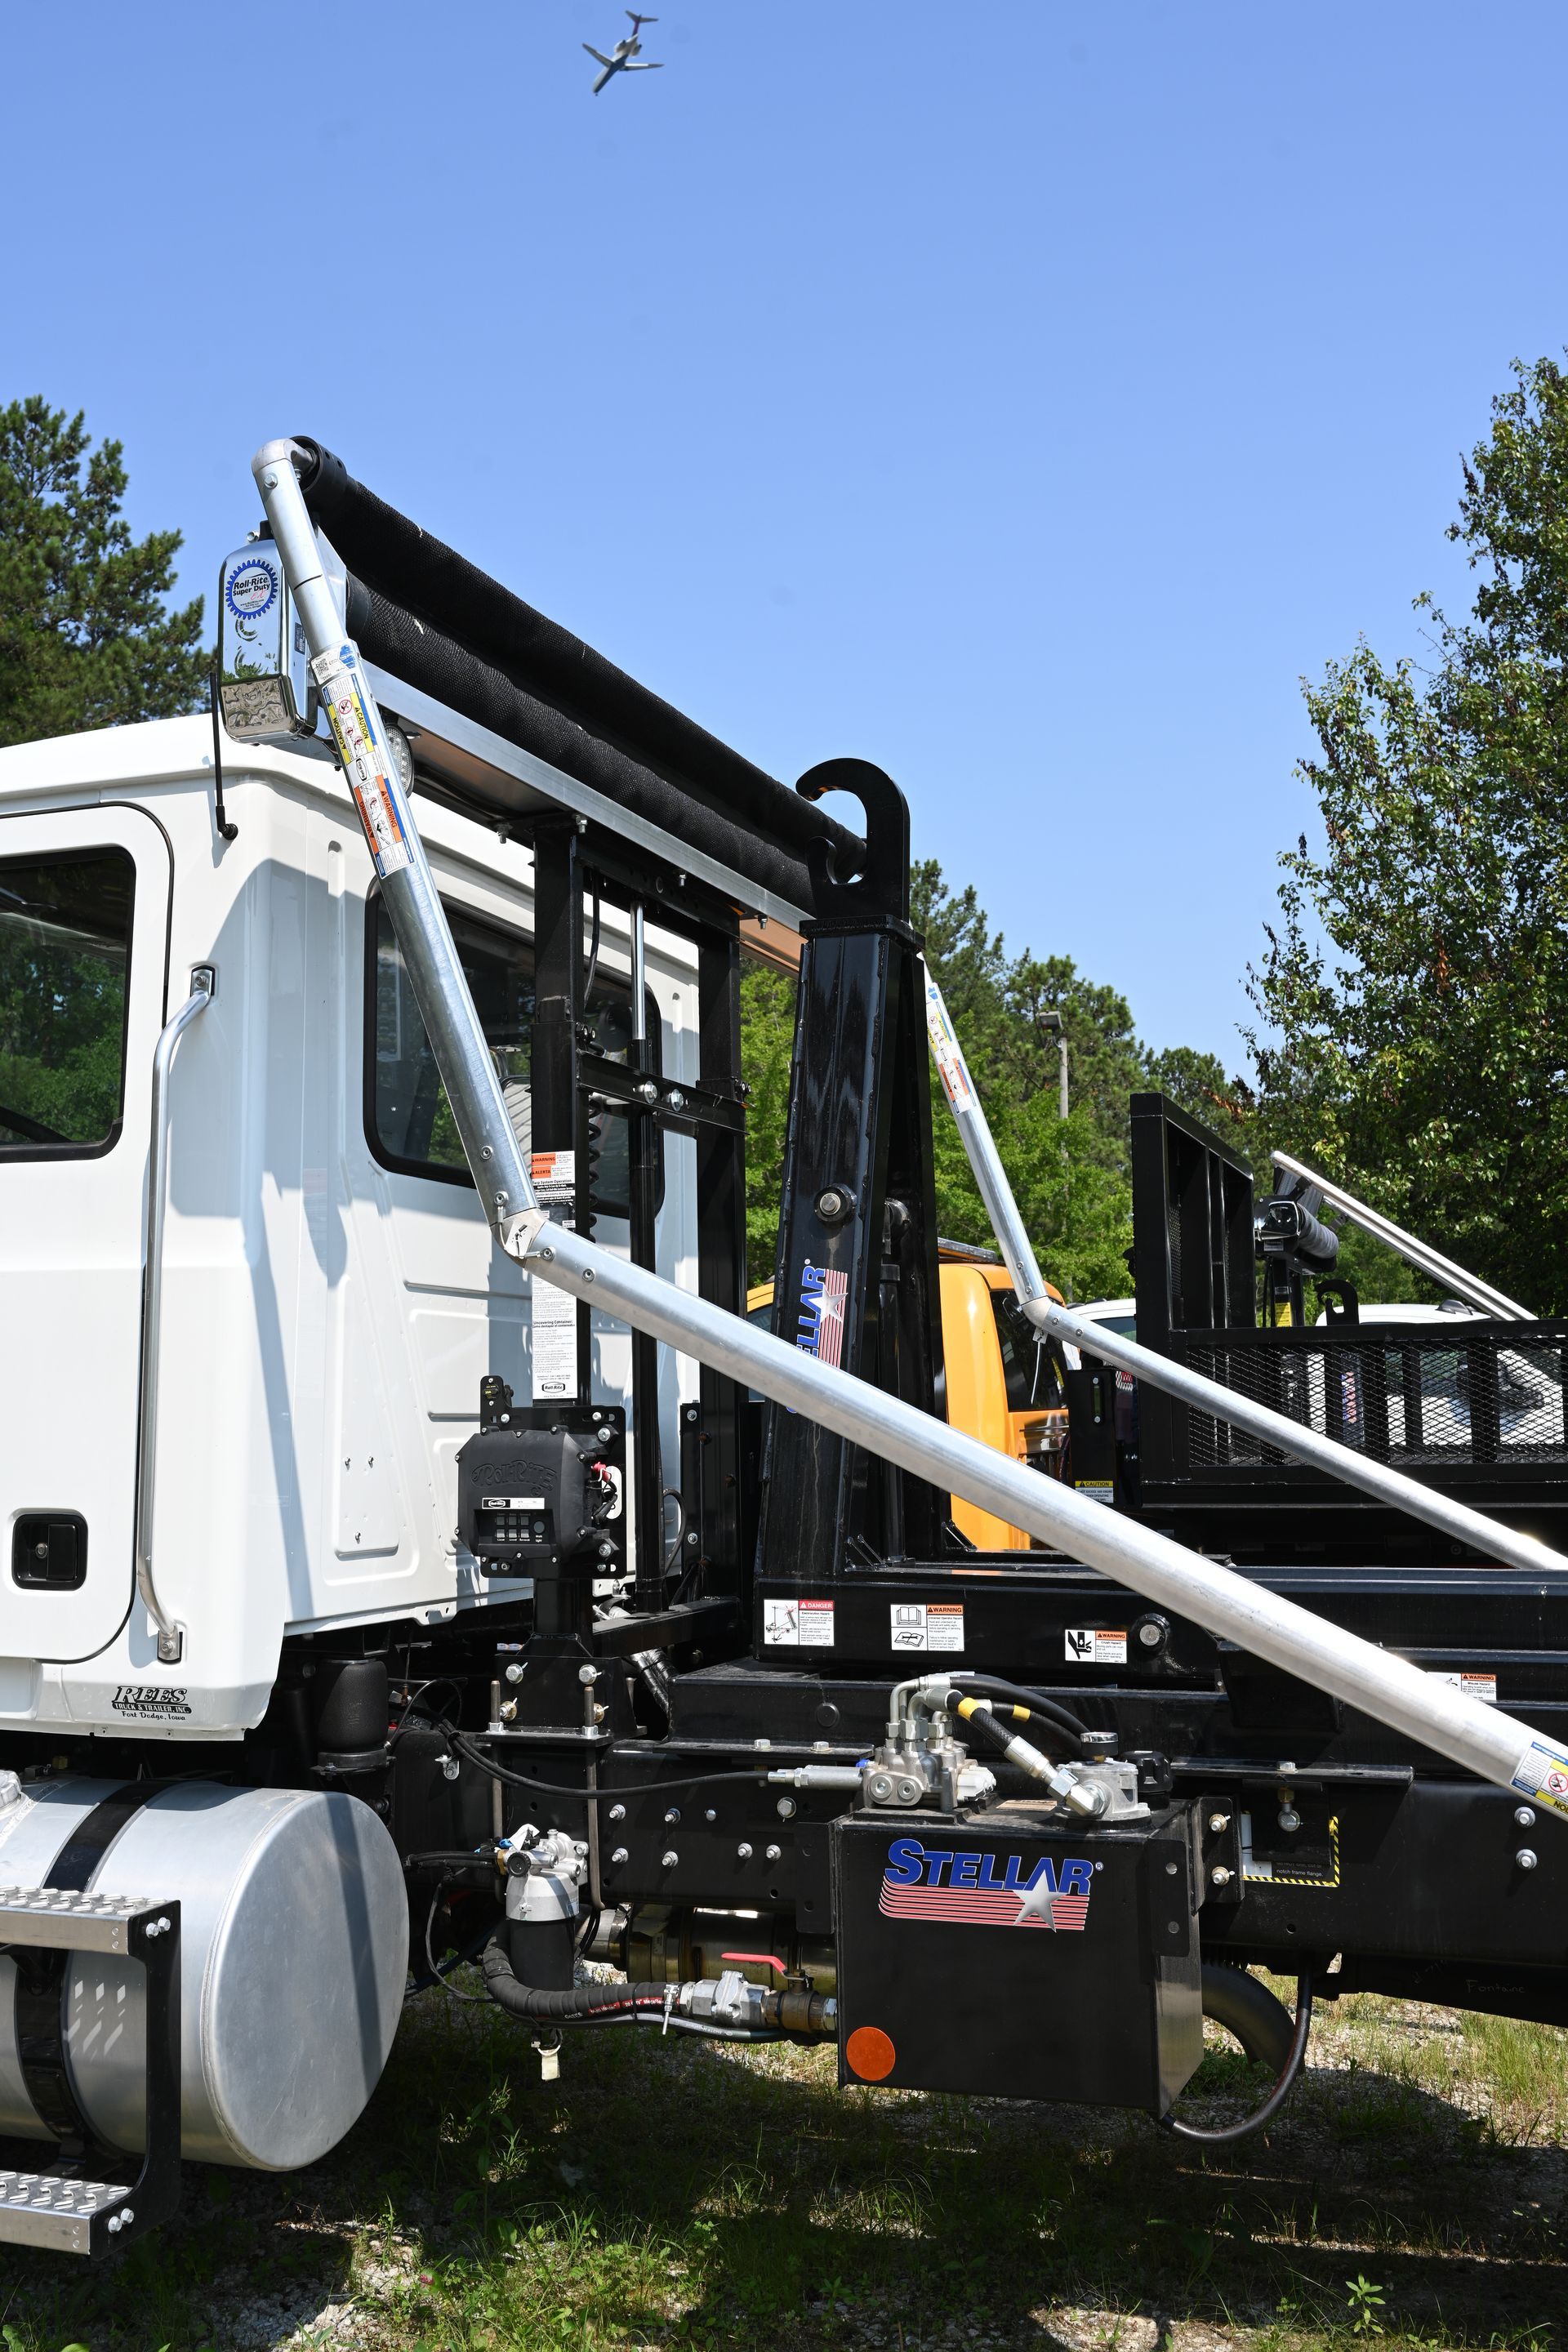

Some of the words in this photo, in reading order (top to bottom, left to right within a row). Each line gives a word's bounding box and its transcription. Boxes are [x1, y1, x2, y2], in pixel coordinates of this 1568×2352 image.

[233, 587, 252, 596] Super
[254, 583, 270, 591] Duty
[332, 717, 345, 744] CAUTION
[356, 712, 369, 739] CAUTION
[359, 801, 373, 833] WARNING
[383, 796, 398, 828] WARNING
[112, 1686, 187, 1704] REES
[884, 1838, 1094, 1895] STELLAR
